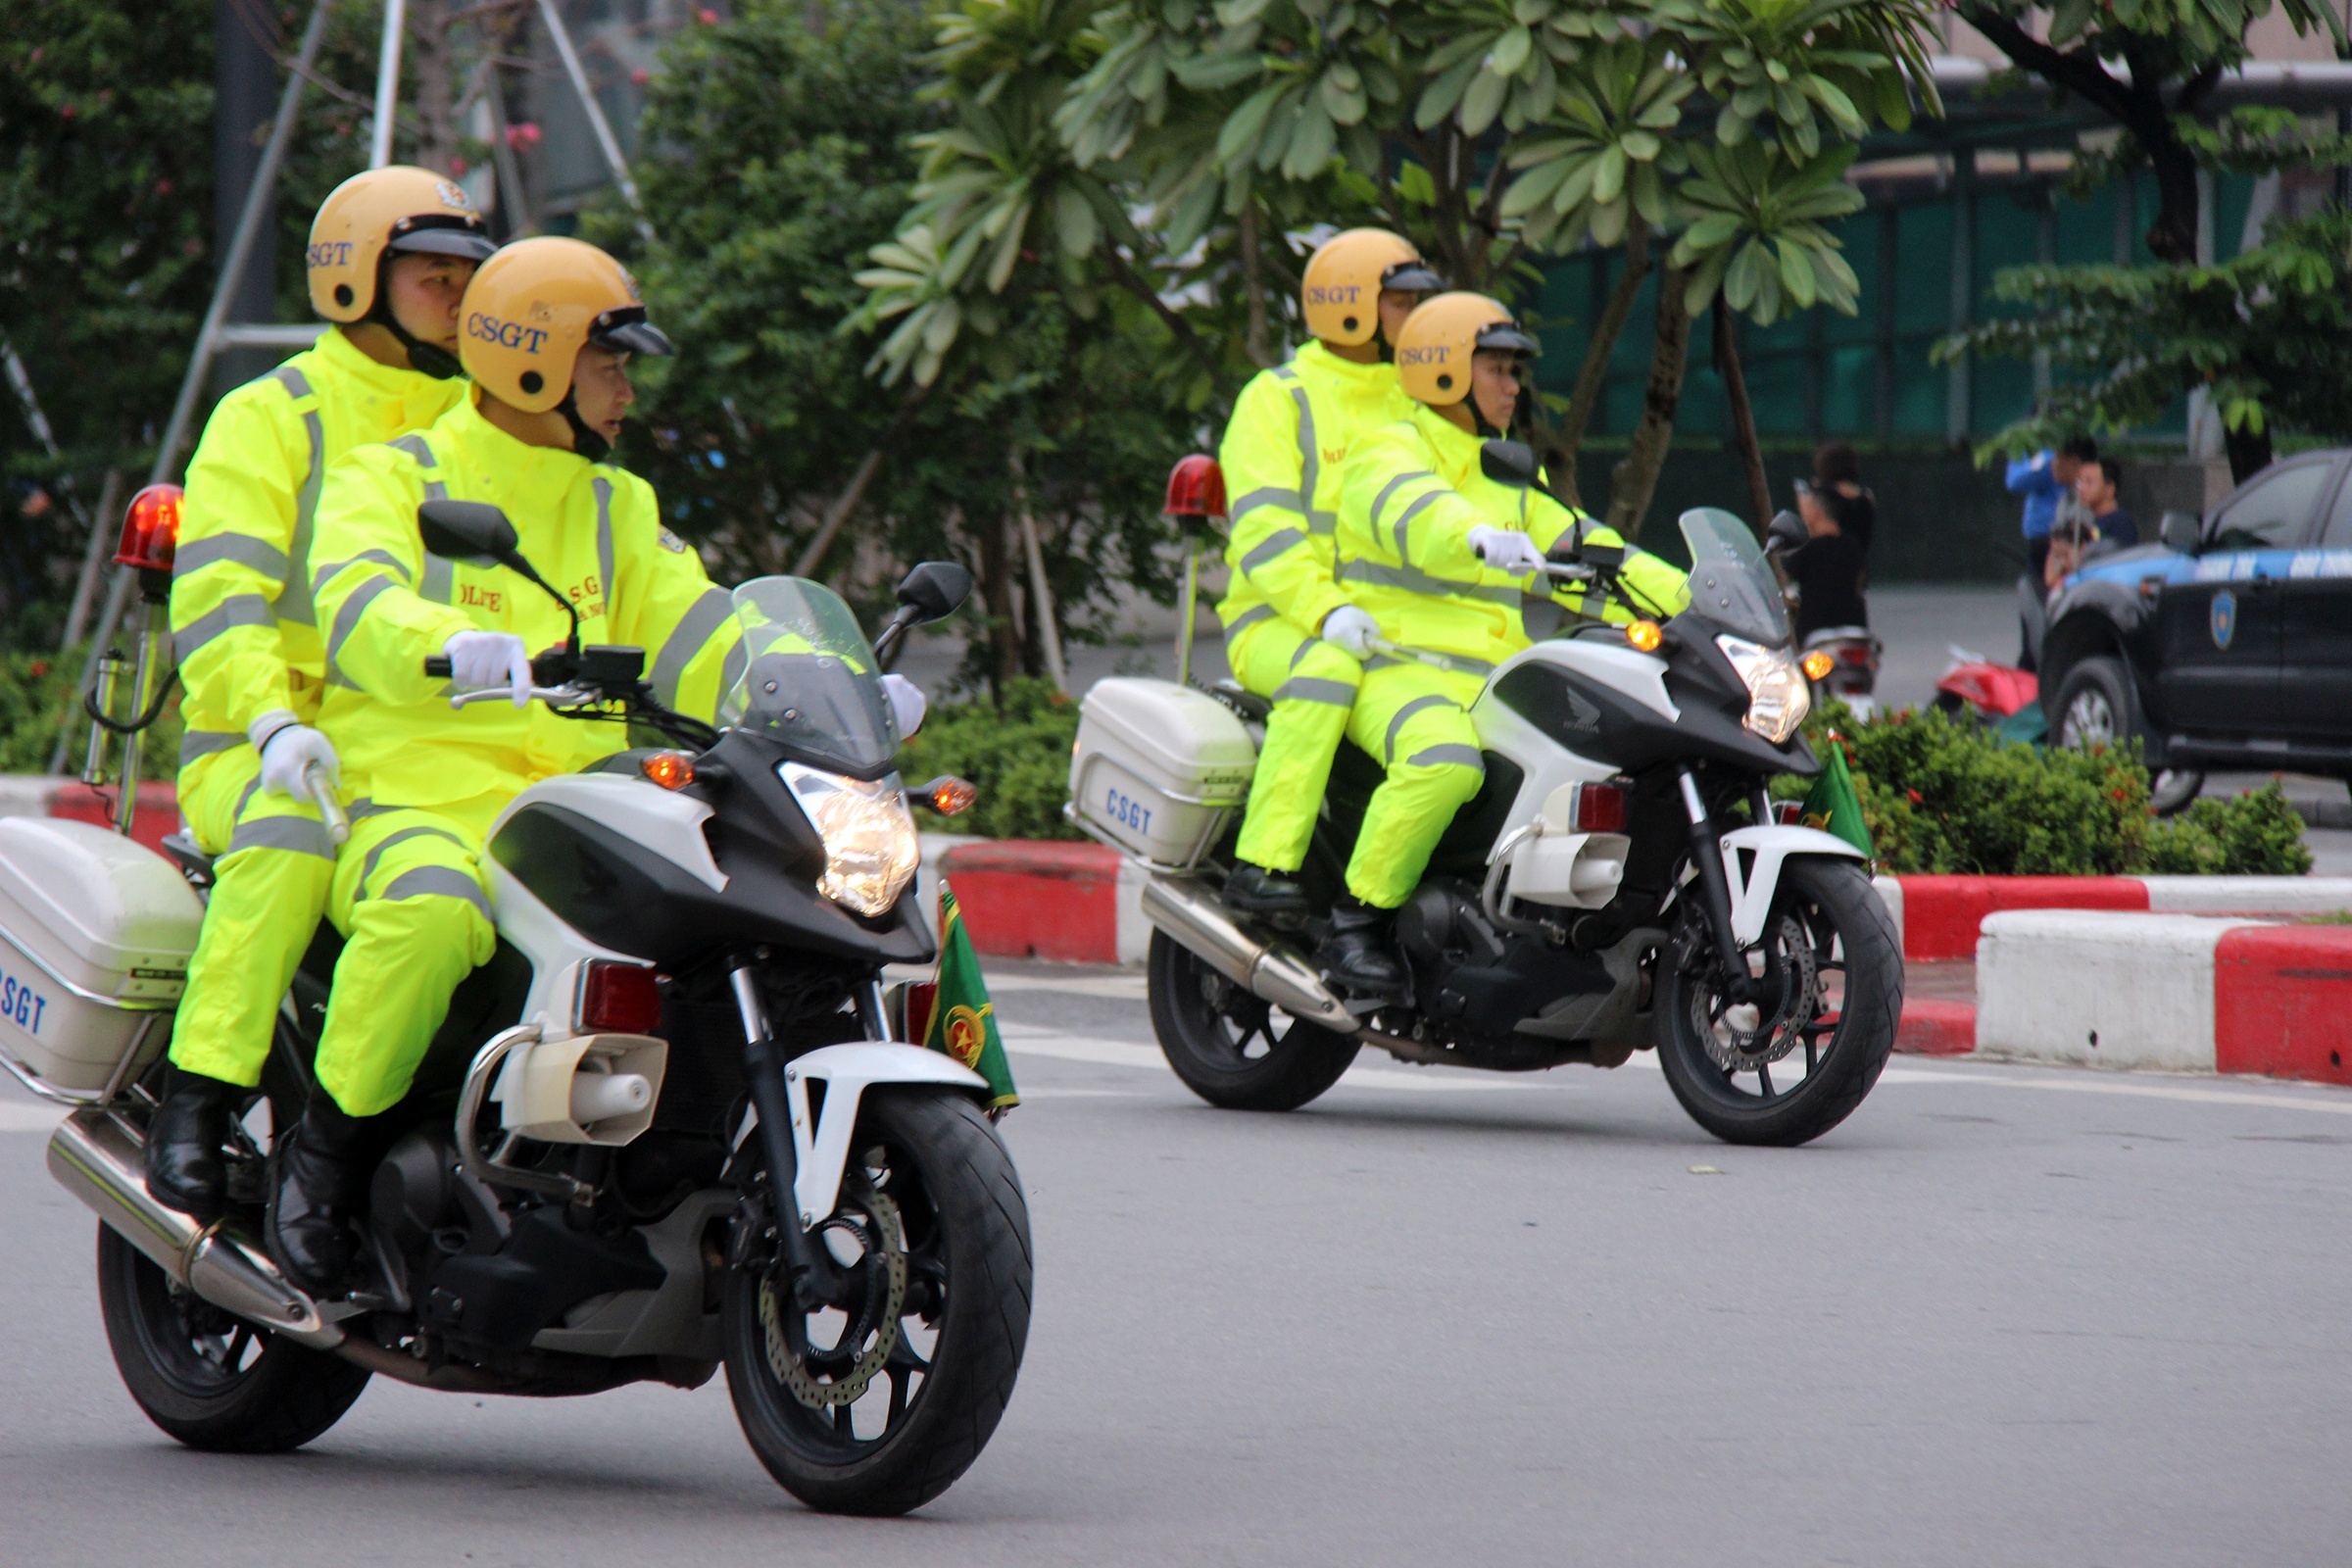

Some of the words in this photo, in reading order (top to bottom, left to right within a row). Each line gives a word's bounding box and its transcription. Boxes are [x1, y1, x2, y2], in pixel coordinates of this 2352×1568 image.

[307, 242, 353, 268] SGT
[1307, 285, 1361, 306] CSGT
[467, 312, 549, 354] CSGT
[1398, 346, 1451, 368] CSGT
[1106, 788, 1152, 835] CSGT
[0, 967, 47, 1035] SGT
